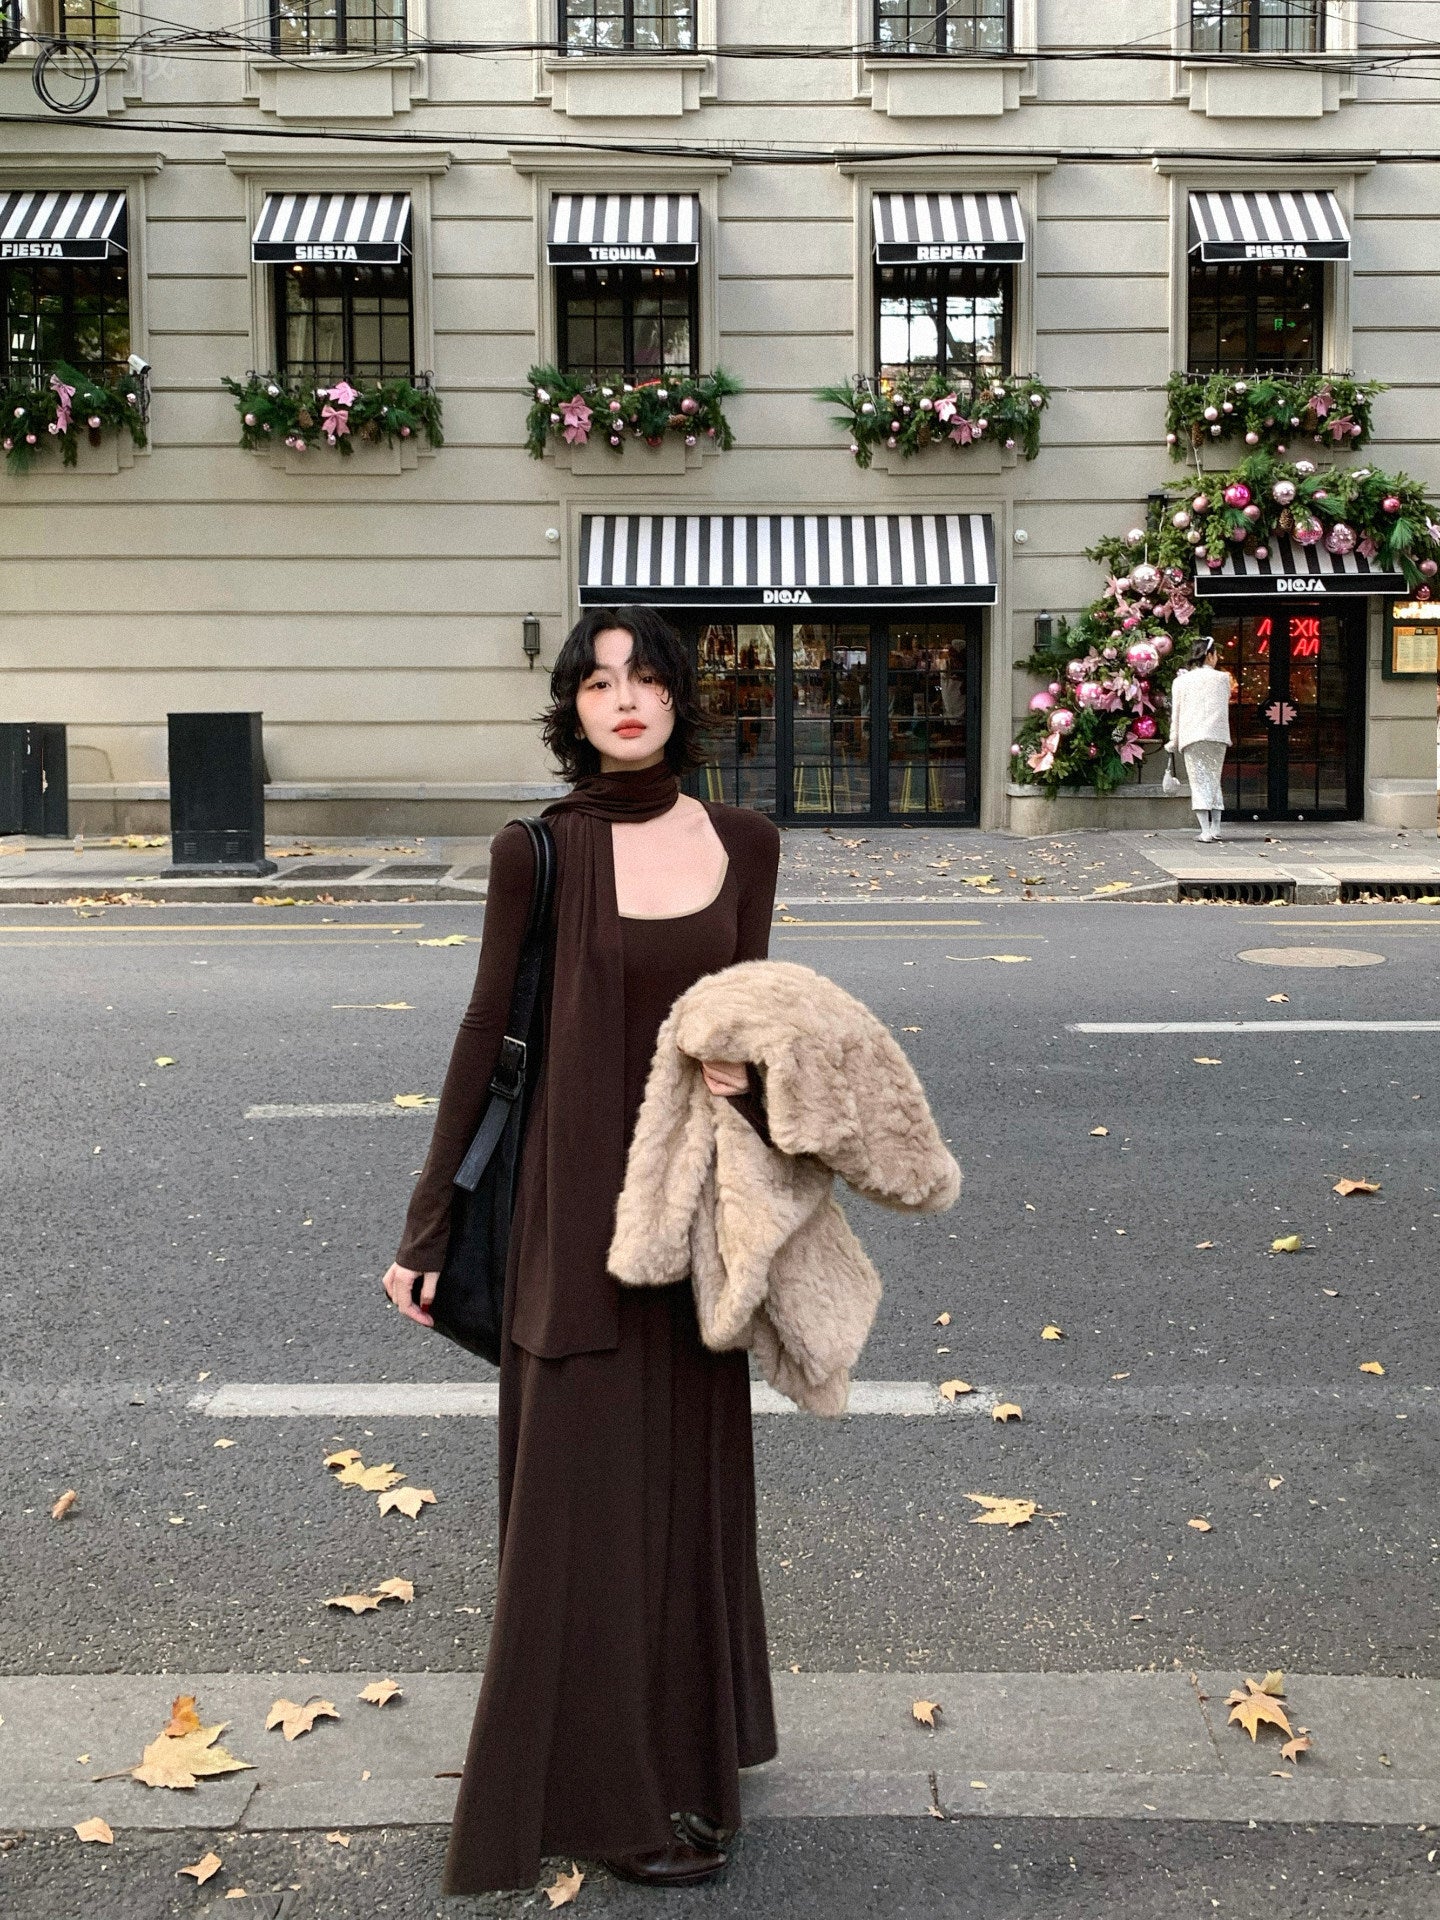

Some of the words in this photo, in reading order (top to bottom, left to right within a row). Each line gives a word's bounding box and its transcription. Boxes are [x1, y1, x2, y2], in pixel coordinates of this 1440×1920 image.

[1, 244, 63, 257] FIESTA
[295, 246, 358, 260] SIESTA
[589, 248, 657, 262] TEQUILA
[917, 246, 986, 260] REPEAT
[1245, 245, 1308, 259] FIESTA
[1277, 579, 1327, 592] DIOSA
[763, 590, 812, 603] DIOSA
